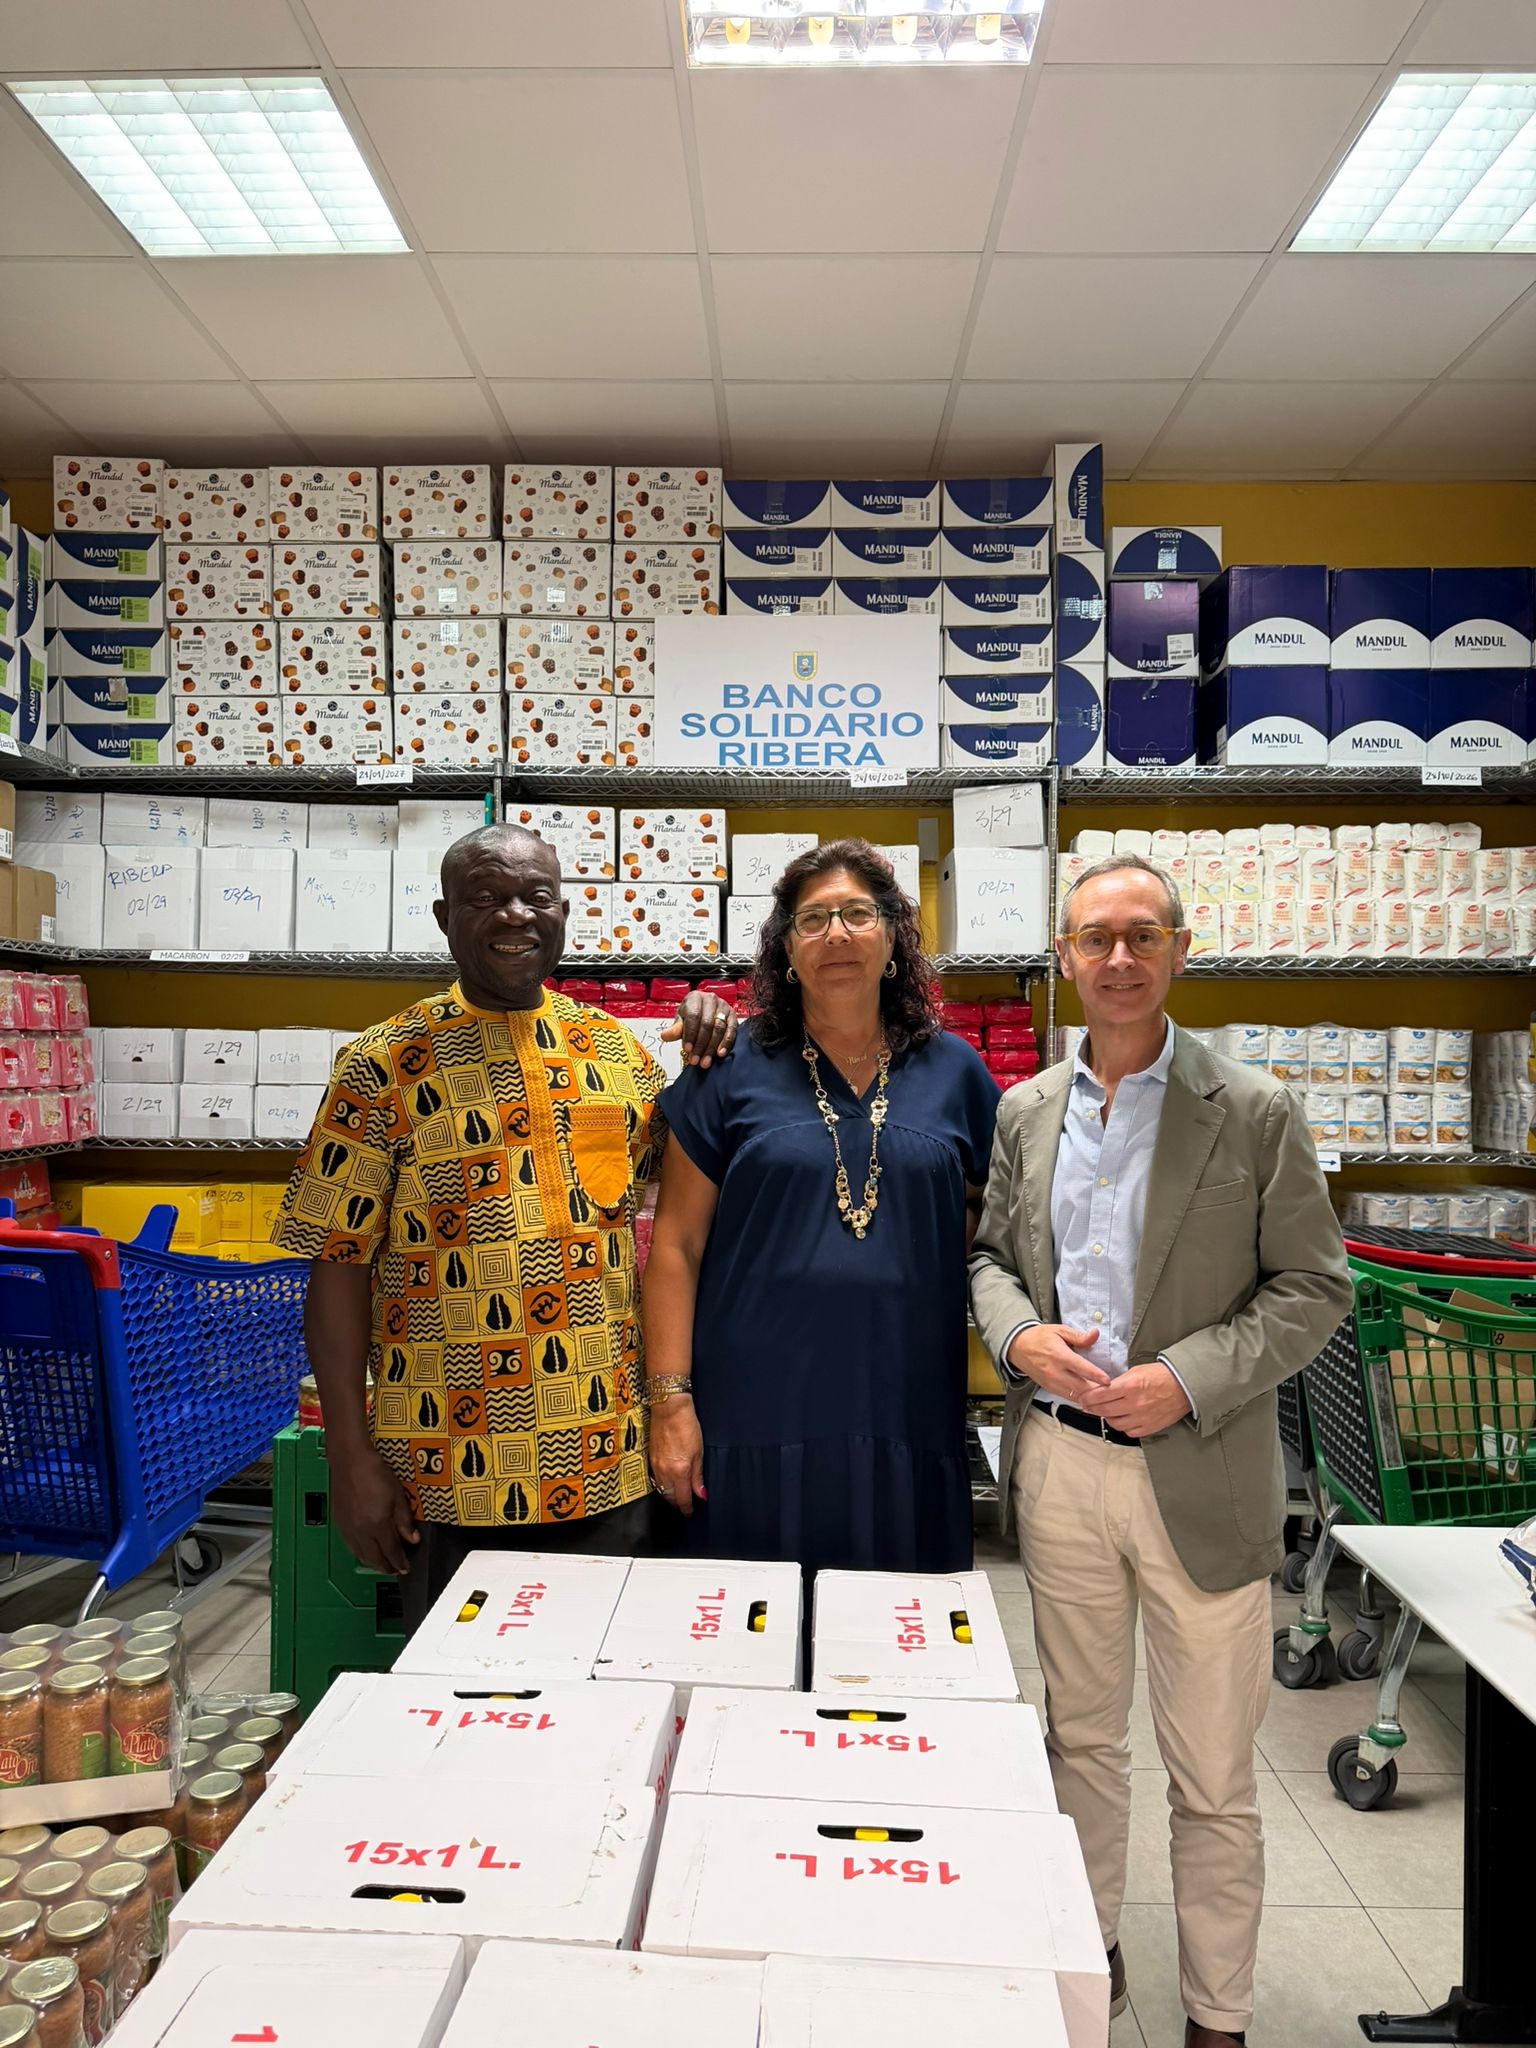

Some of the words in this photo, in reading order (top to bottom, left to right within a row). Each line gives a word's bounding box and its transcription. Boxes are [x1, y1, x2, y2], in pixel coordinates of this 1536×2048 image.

[88, 470, 124, 481] Mandul
[197, 483, 230, 492] Mandul
[300, 481, 335, 492] Mandul
[417, 479, 451, 488] Mandul
[539, 479, 573, 488] Mandul
[648, 480, 682, 491] Mandul
[863, 494, 904, 506] MANDU
[984, 512, 1012, 520] MANDUL
[756, 545, 796, 556] MANDU
[864, 544, 904, 555] MANDU
[198, 558, 232, 569] Mandul
[304, 558, 338, 569] Mandul
[429, 557, 463, 566] Mandul
[538, 556, 572, 565] Mandul
[644, 558, 678, 568] Mandul
[758, 594, 800, 605] MANDUL
[1254, 633, 1306, 645] MANDUL
[1356, 635, 1408, 648] MANDUL
[1454, 635, 1506, 648] MANDUL
[976, 642, 1020, 654] MANDUL
[722, 682, 882, 708] BANCO
[207, 710, 242, 720] Mandul
[314, 709, 349, 720] Mandul
[428, 709, 462, 718] Mandul
[542, 708, 576, 718] Mandul
[680, 712, 924, 738] SOLIDARIO
[1252, 732, 1304, 744] MANDUL
[1352, 736, 1403, 750] MANDUL
[1450, 736, 1502, 750] MANDUL
[718, 742, 886, 766] RIBERA
[1138, 756, 1167, 764] MANDUL
[539, 819, 574, 830] Mandul
[652, 823, 686, 834] Mandul
[644, 897, 678, 907] Mandul
[160, 952, 210, 960] MACARRON
[221, 952, 244, 960] 02/29
[203, 1040, 242, 1057] 2/29
[122, 1097, 162, 1112] 2/29
[201, 1096, 233, 1113] 2/29
[507, 1582, 548, 1617] 15x1
[698, 1588, 726, 1600] L.
[894, 1598, 921, 1610] L.
[690, 1606, 724, 1640] 15x1
[496, 1623, 530, 1637] L.
[895, 1616, 927, 1652] 15x1
[408, 1708, 443, 1726] L.
[458, 1711, 556, 1730] 15x1
[780, 1730, 816, 1747] L.
[838, 1733, 936, 1752] 15x1
[344, 1840, 460, 1868] 15x1
[478, 1846, 522, 1869] L.
[776, 1853, 817, 1878] L.
[844, 1857, 960, 1884] 15x1
